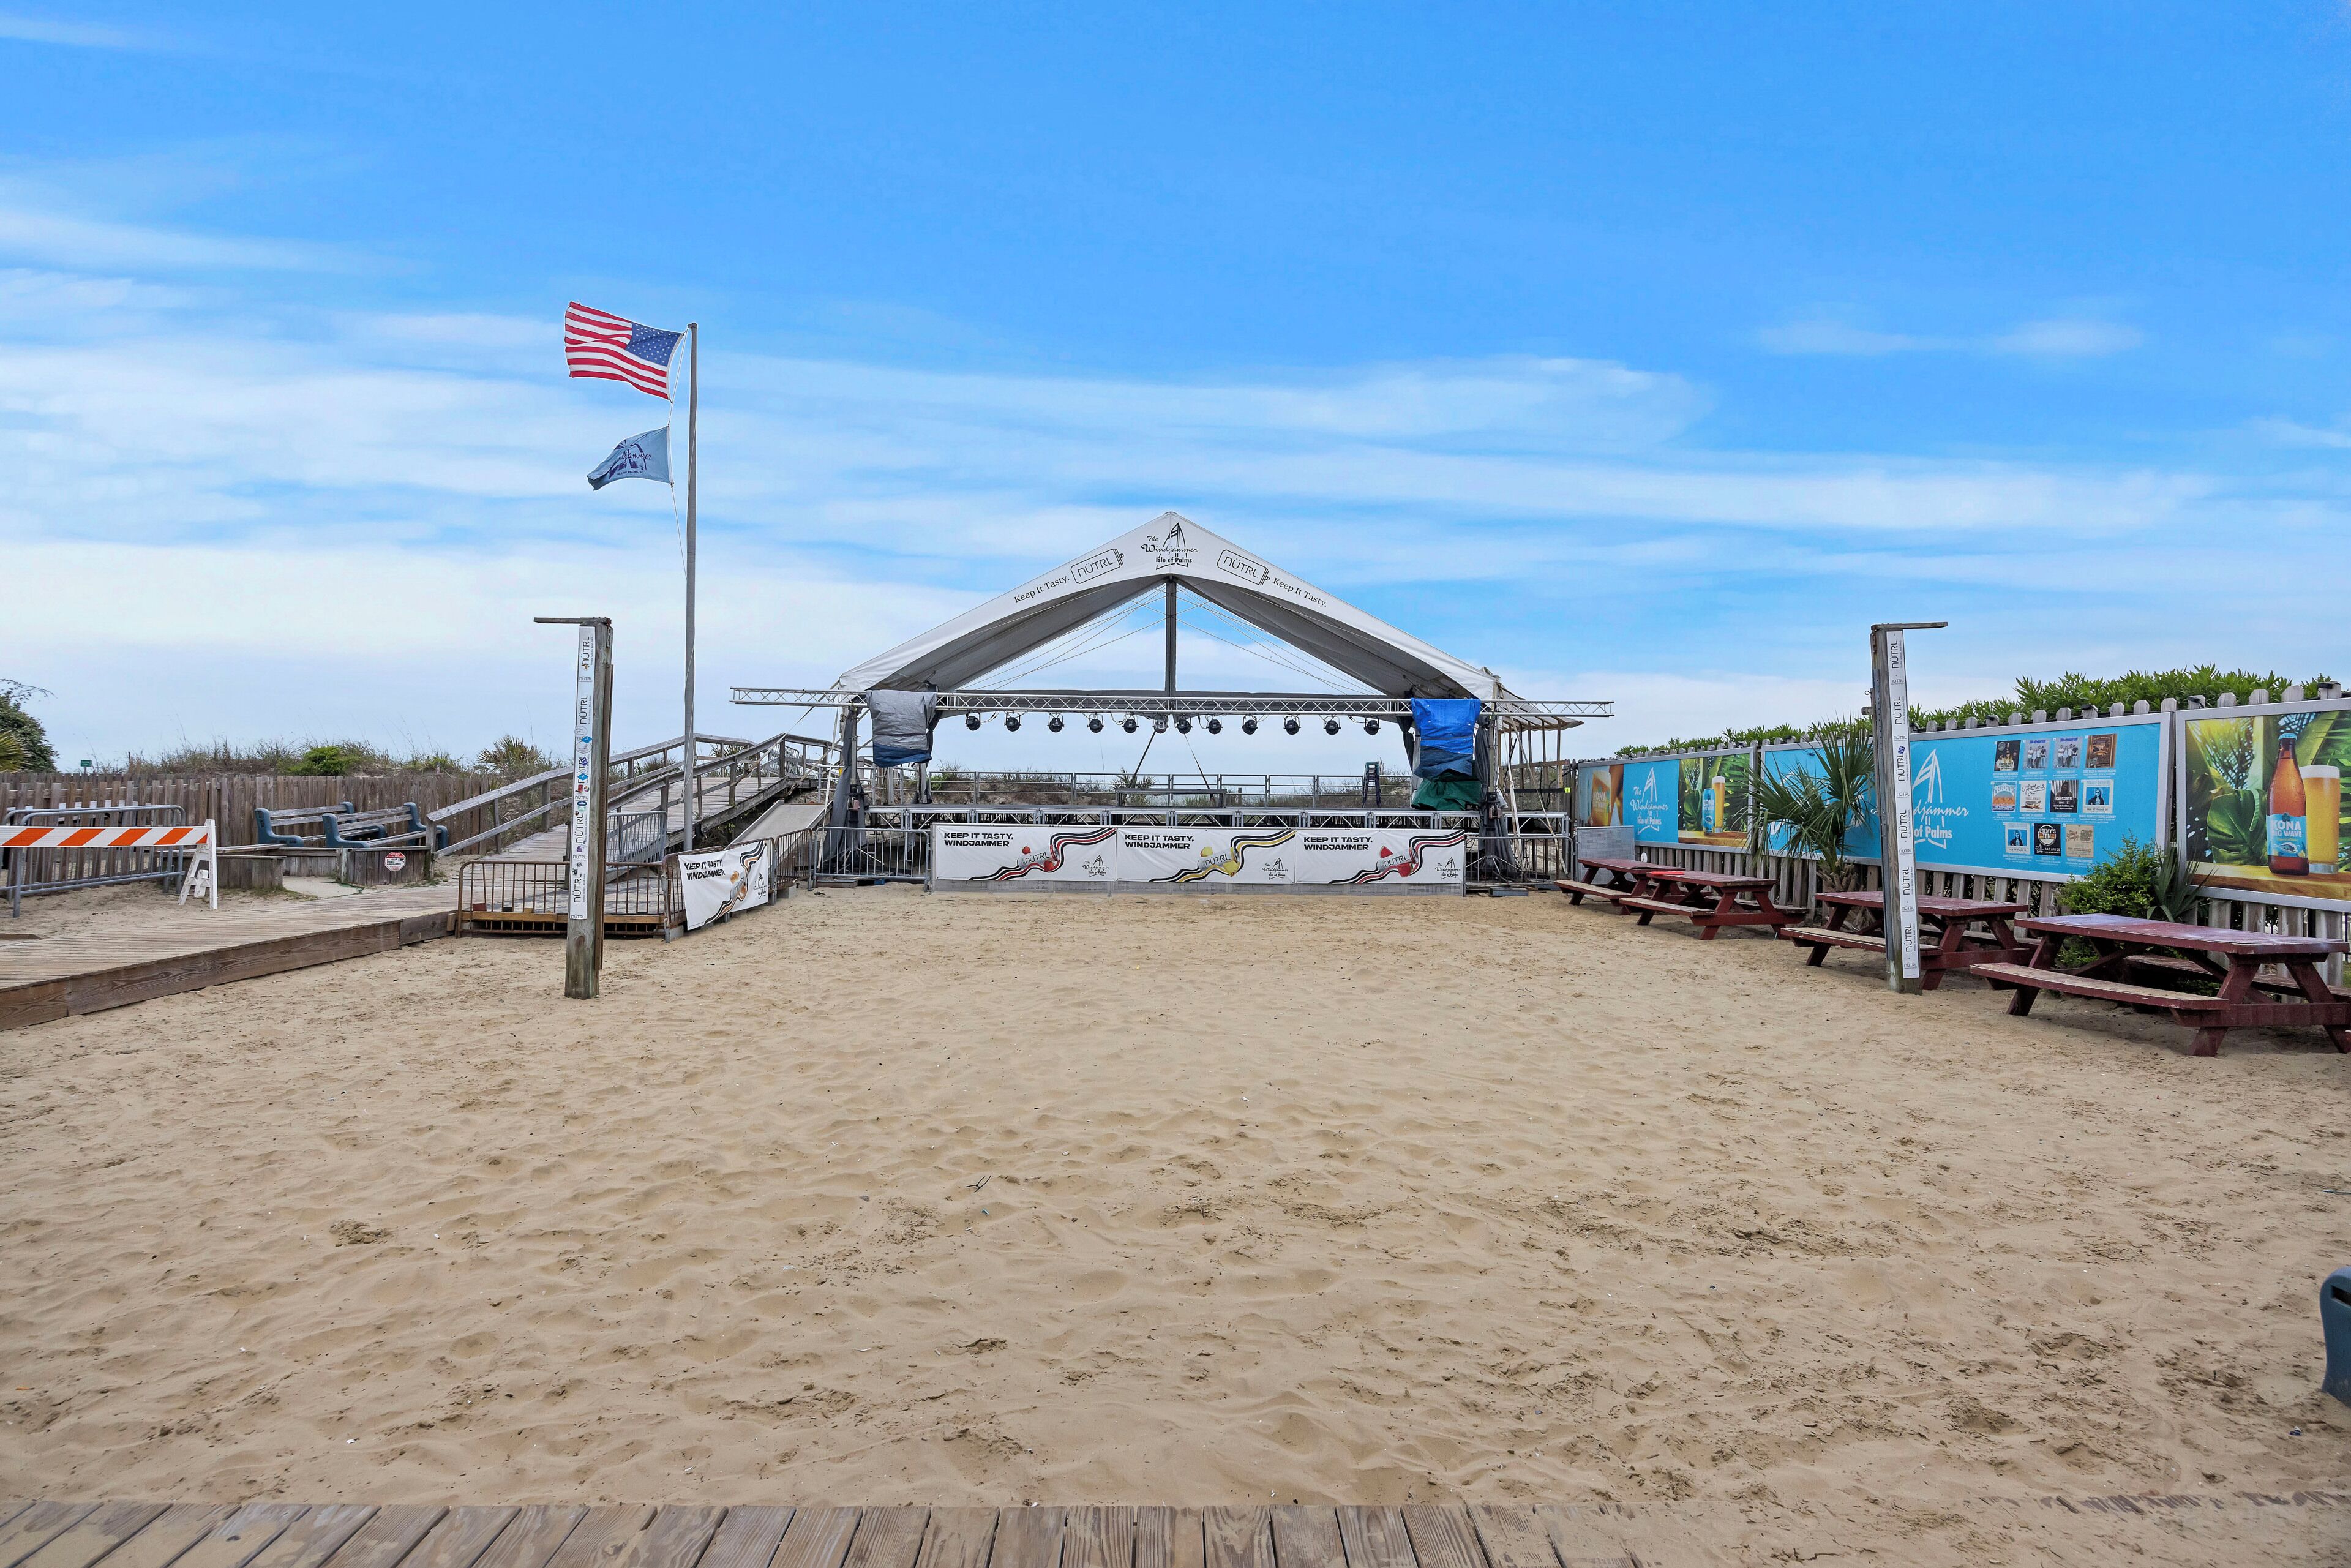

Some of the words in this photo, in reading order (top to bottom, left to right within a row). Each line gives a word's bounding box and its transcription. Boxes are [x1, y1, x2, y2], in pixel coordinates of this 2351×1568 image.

[1141, 544, 1198, 555] Windjammer
[1014, 590, 1035, 603] Keep
[1036, 586, 1044, 594] It
[1044, 576, 1070, 590] Tasty.
[1273, 578, 1294, 592] Keep
[1304, 591, 1326, 607] Tasty.
[1630, 799, 1668, 814] Windjammer
[1914, 825, 1923, 837] of
[1925, 825, 1953, 838] Palms
[2271, 820, 2301, 831] KONA
[1024, 851, 1050, 864] NÜTRL
[1205, 853, 1231, 867] NÜTRL
[1384, 854, 1409, 867] NÜTRL
